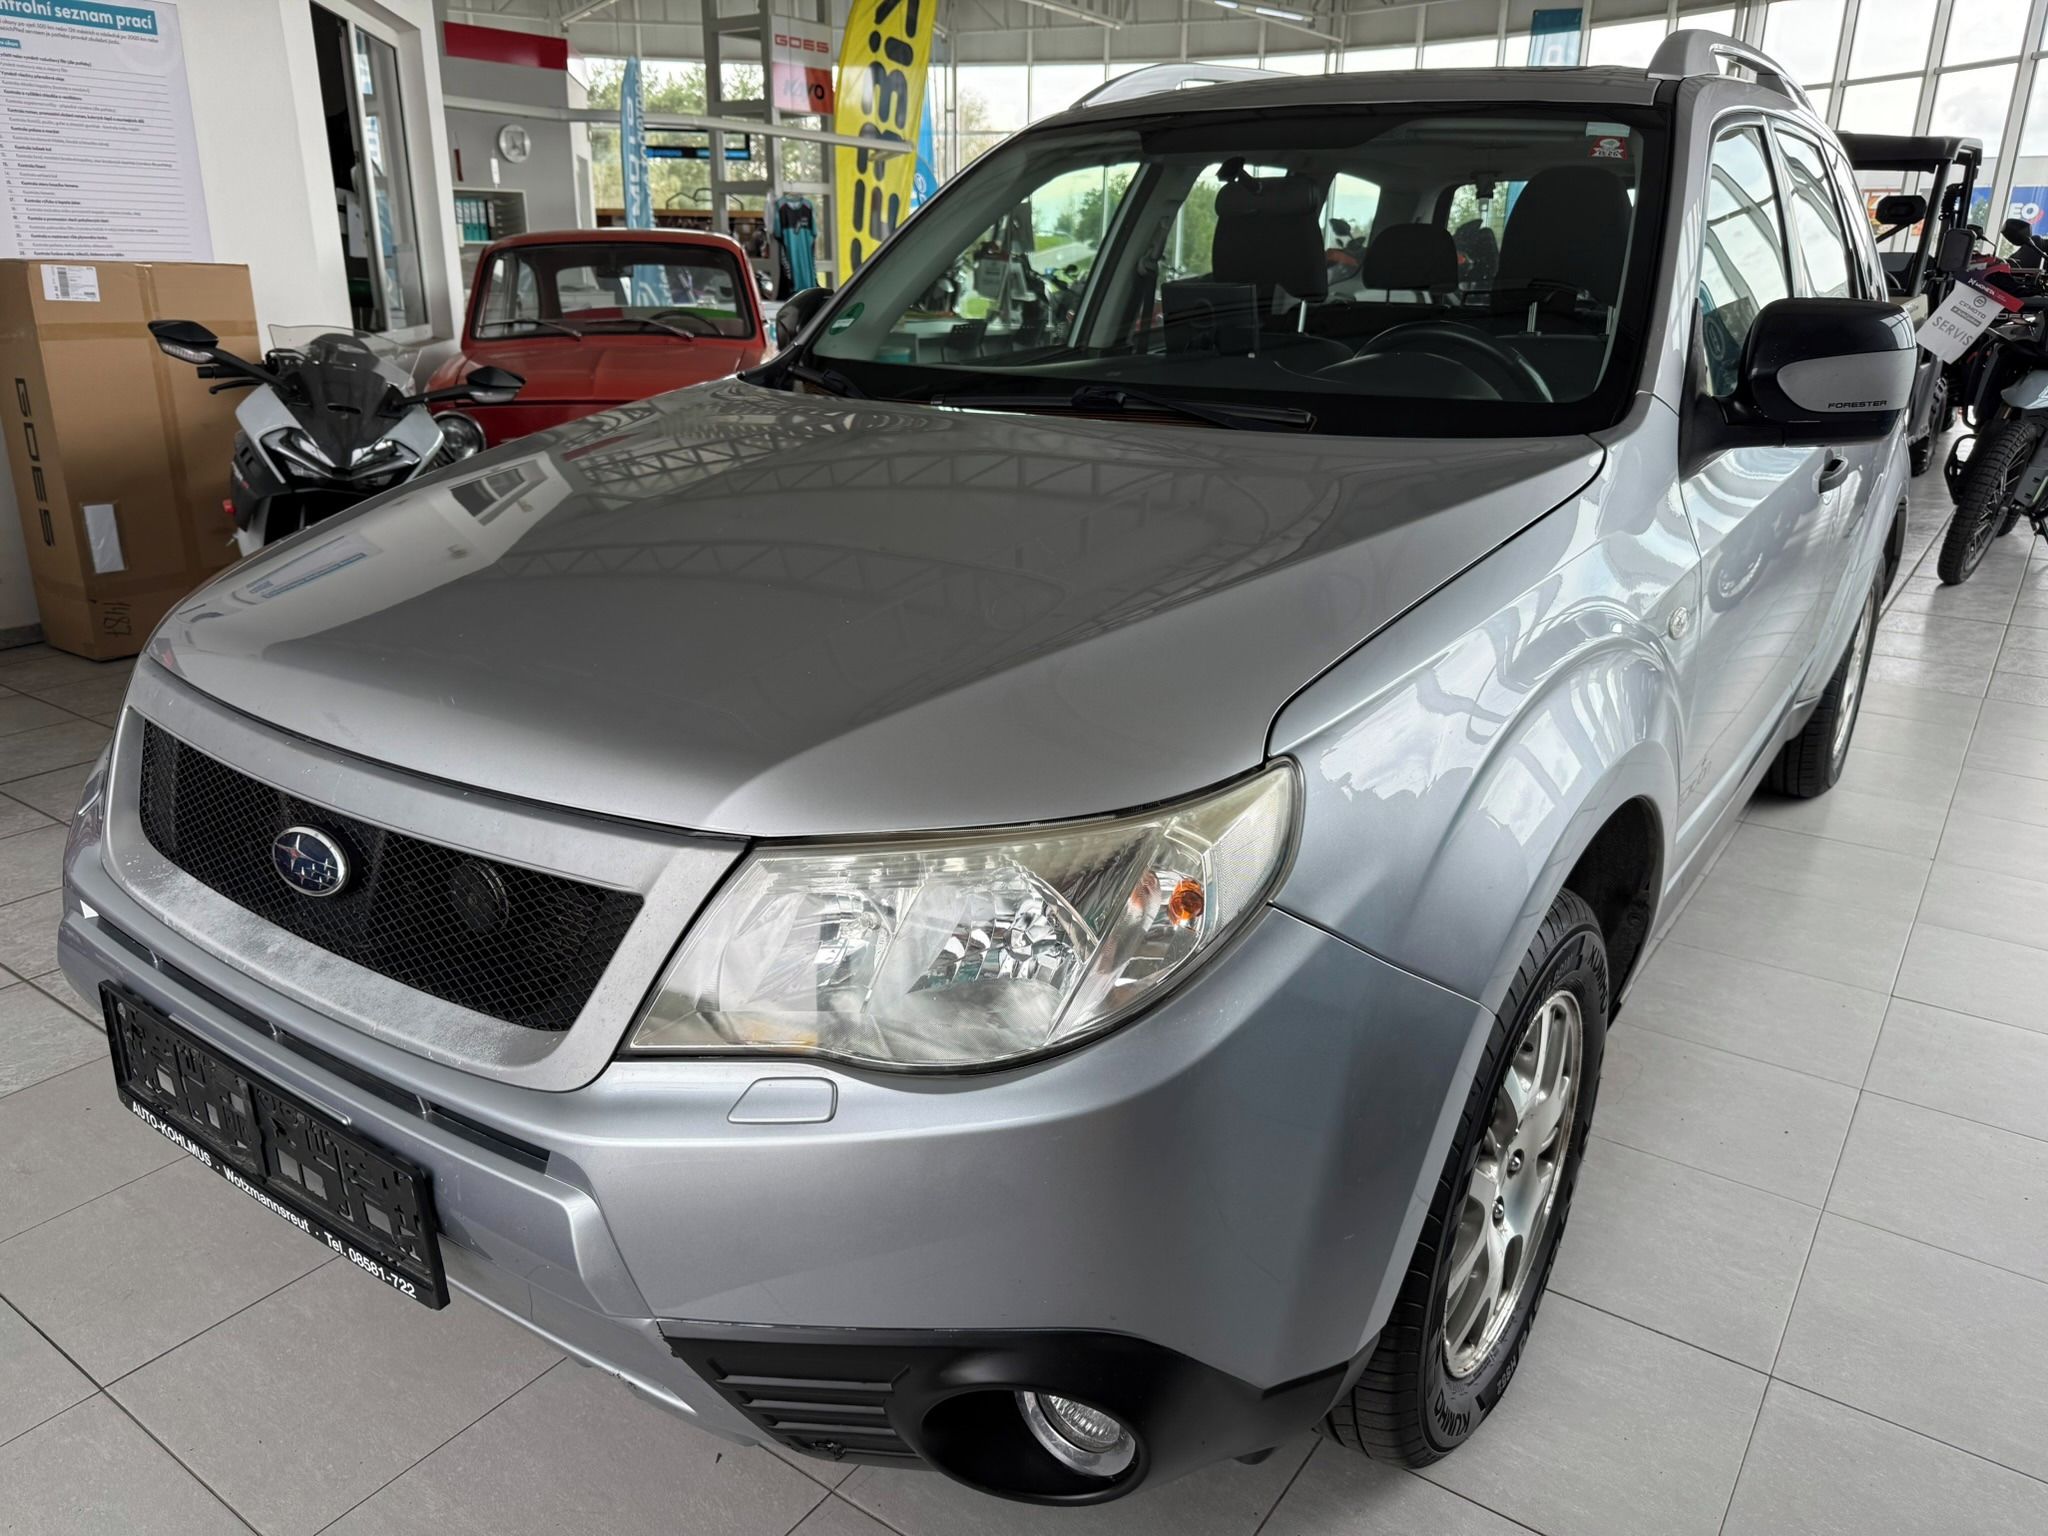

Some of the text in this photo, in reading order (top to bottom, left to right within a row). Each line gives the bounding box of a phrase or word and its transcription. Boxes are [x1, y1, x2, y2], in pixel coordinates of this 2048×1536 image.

[54, 6, 113, 24] seznam
[116, 14, 153, 30] prací
[775, 34, 829, 54] GOES
[1959, 300, 1986, 320] CFMOTO
[1932, 316, 1974, 346] SERVIS
[1827, 400, 1888, 409] FORESTER
[15, 378, 56, 546] GOES
[1587, 944, 1608, 1015] KUMHO
[132, 1101, 417, 1299] AUTO-KOHLMUS Wotzmannsreut Tel. 08581-722
[1434, 1388, 1471, 1434] KUMHO
